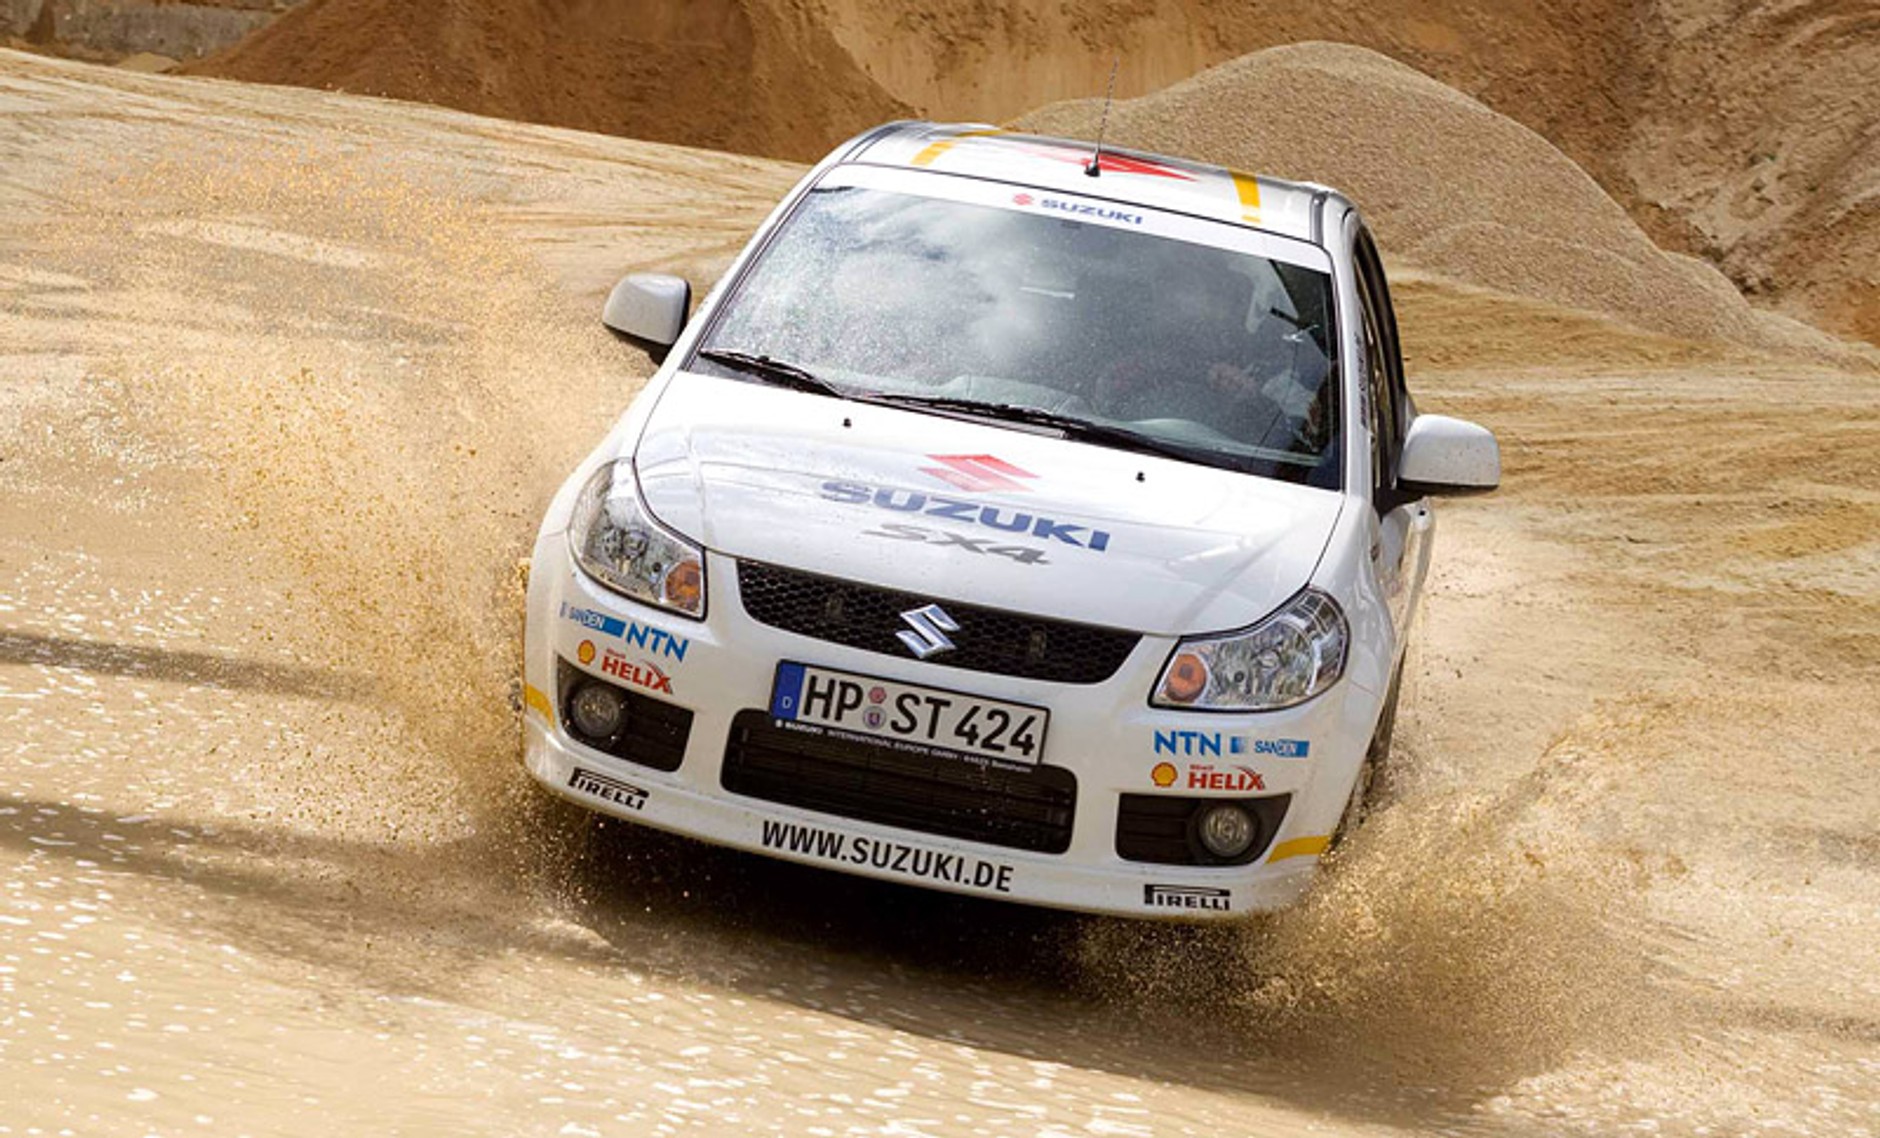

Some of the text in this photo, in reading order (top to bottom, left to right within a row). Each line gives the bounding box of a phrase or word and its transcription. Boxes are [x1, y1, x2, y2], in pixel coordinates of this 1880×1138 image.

[1041, 199, 1143, 224] SUZUKI
[821, 482, 1110, 551] SUZUKI
[860, 523, 1051, 564] SX4
[626, 621, 689, 662] NTN
[601, 655, 673, 695] HELIX
[803, 675, 1036, 756] HP ST 424
[1153, 731, 1221, 756] NTN
[568, 767, 649, 810] PIRELLI
[1188, 765, 1265, 791] HELIX
[762, 820, 1014, 892] WWW.SUZUKI.DE
[1144, 884, 1230, 911] PIRELLI
